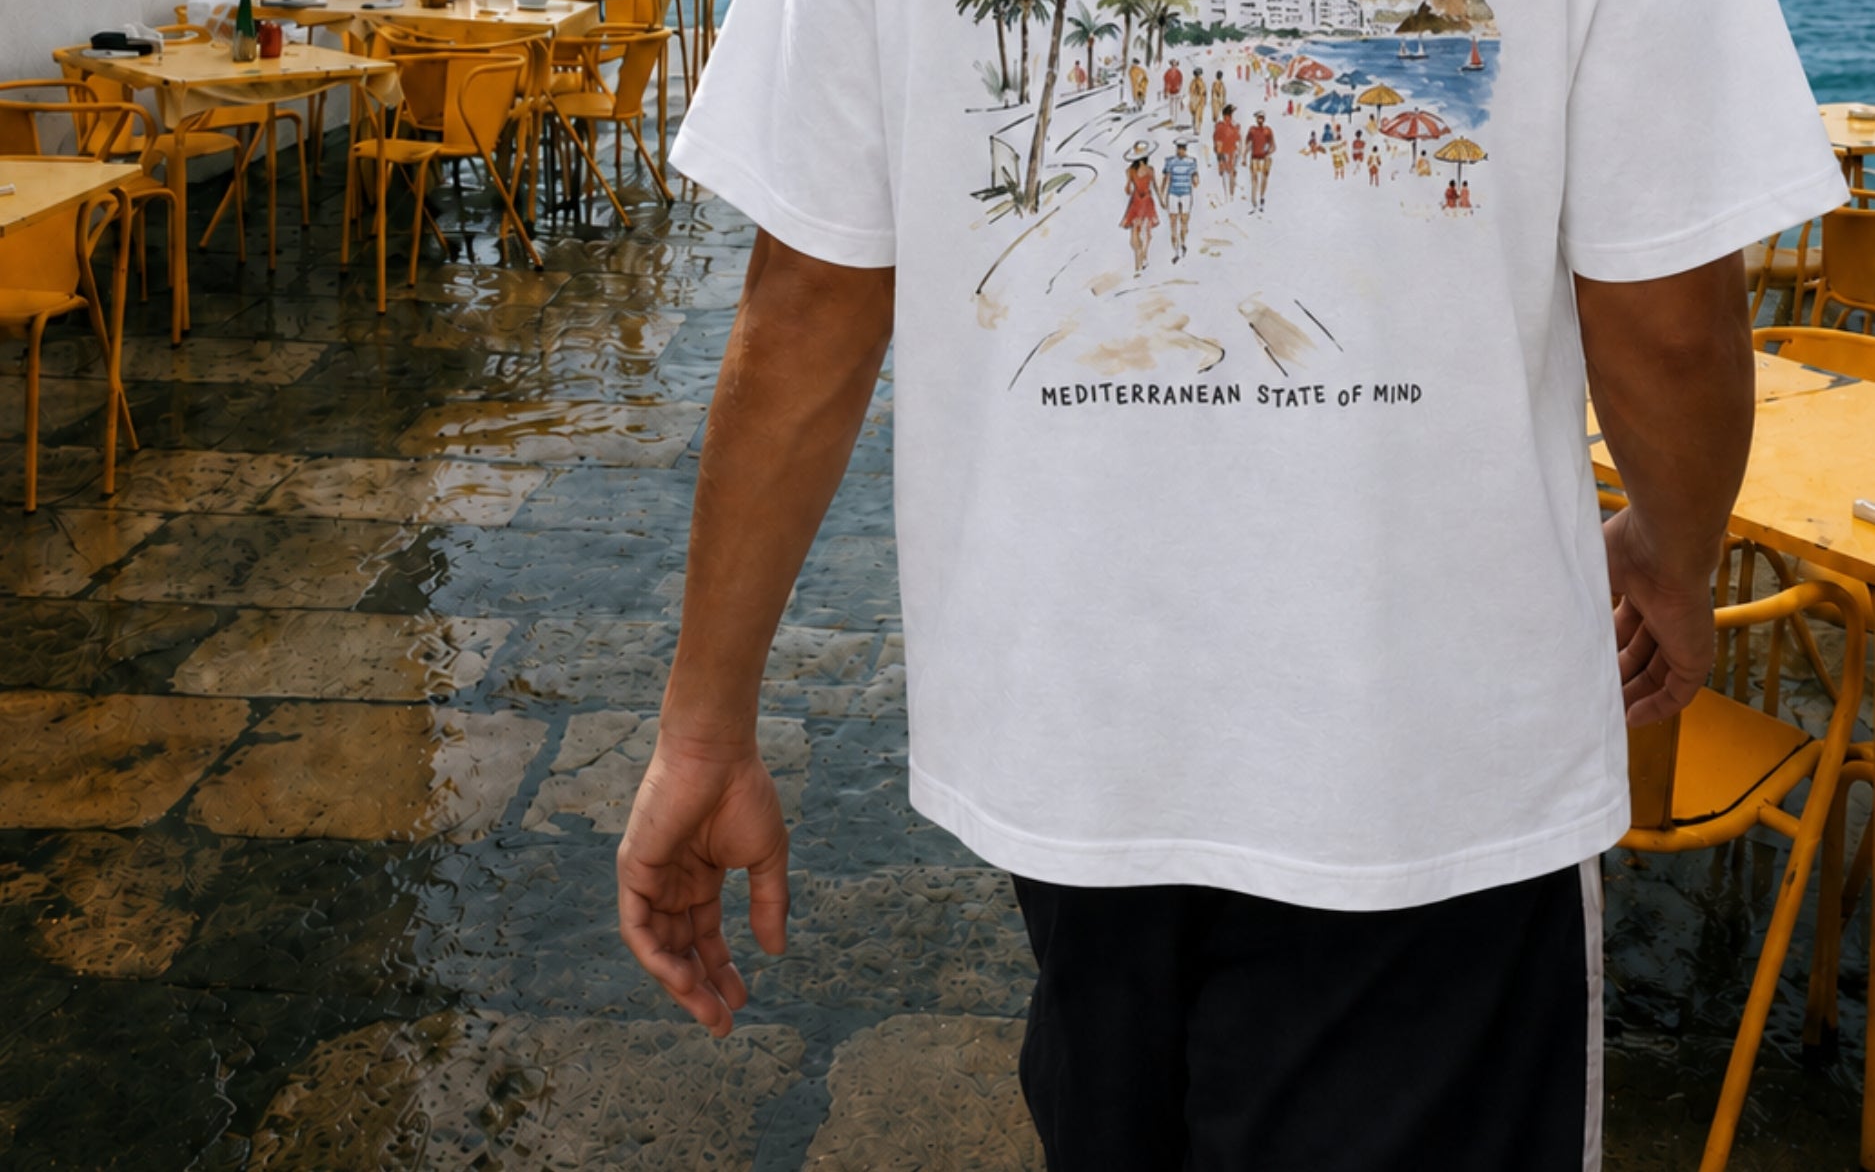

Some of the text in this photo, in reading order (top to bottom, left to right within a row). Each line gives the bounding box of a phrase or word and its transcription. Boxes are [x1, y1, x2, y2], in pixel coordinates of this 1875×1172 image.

[1041, 383, 1422, 408] MEDITERRANEAN STATE OF MIND
